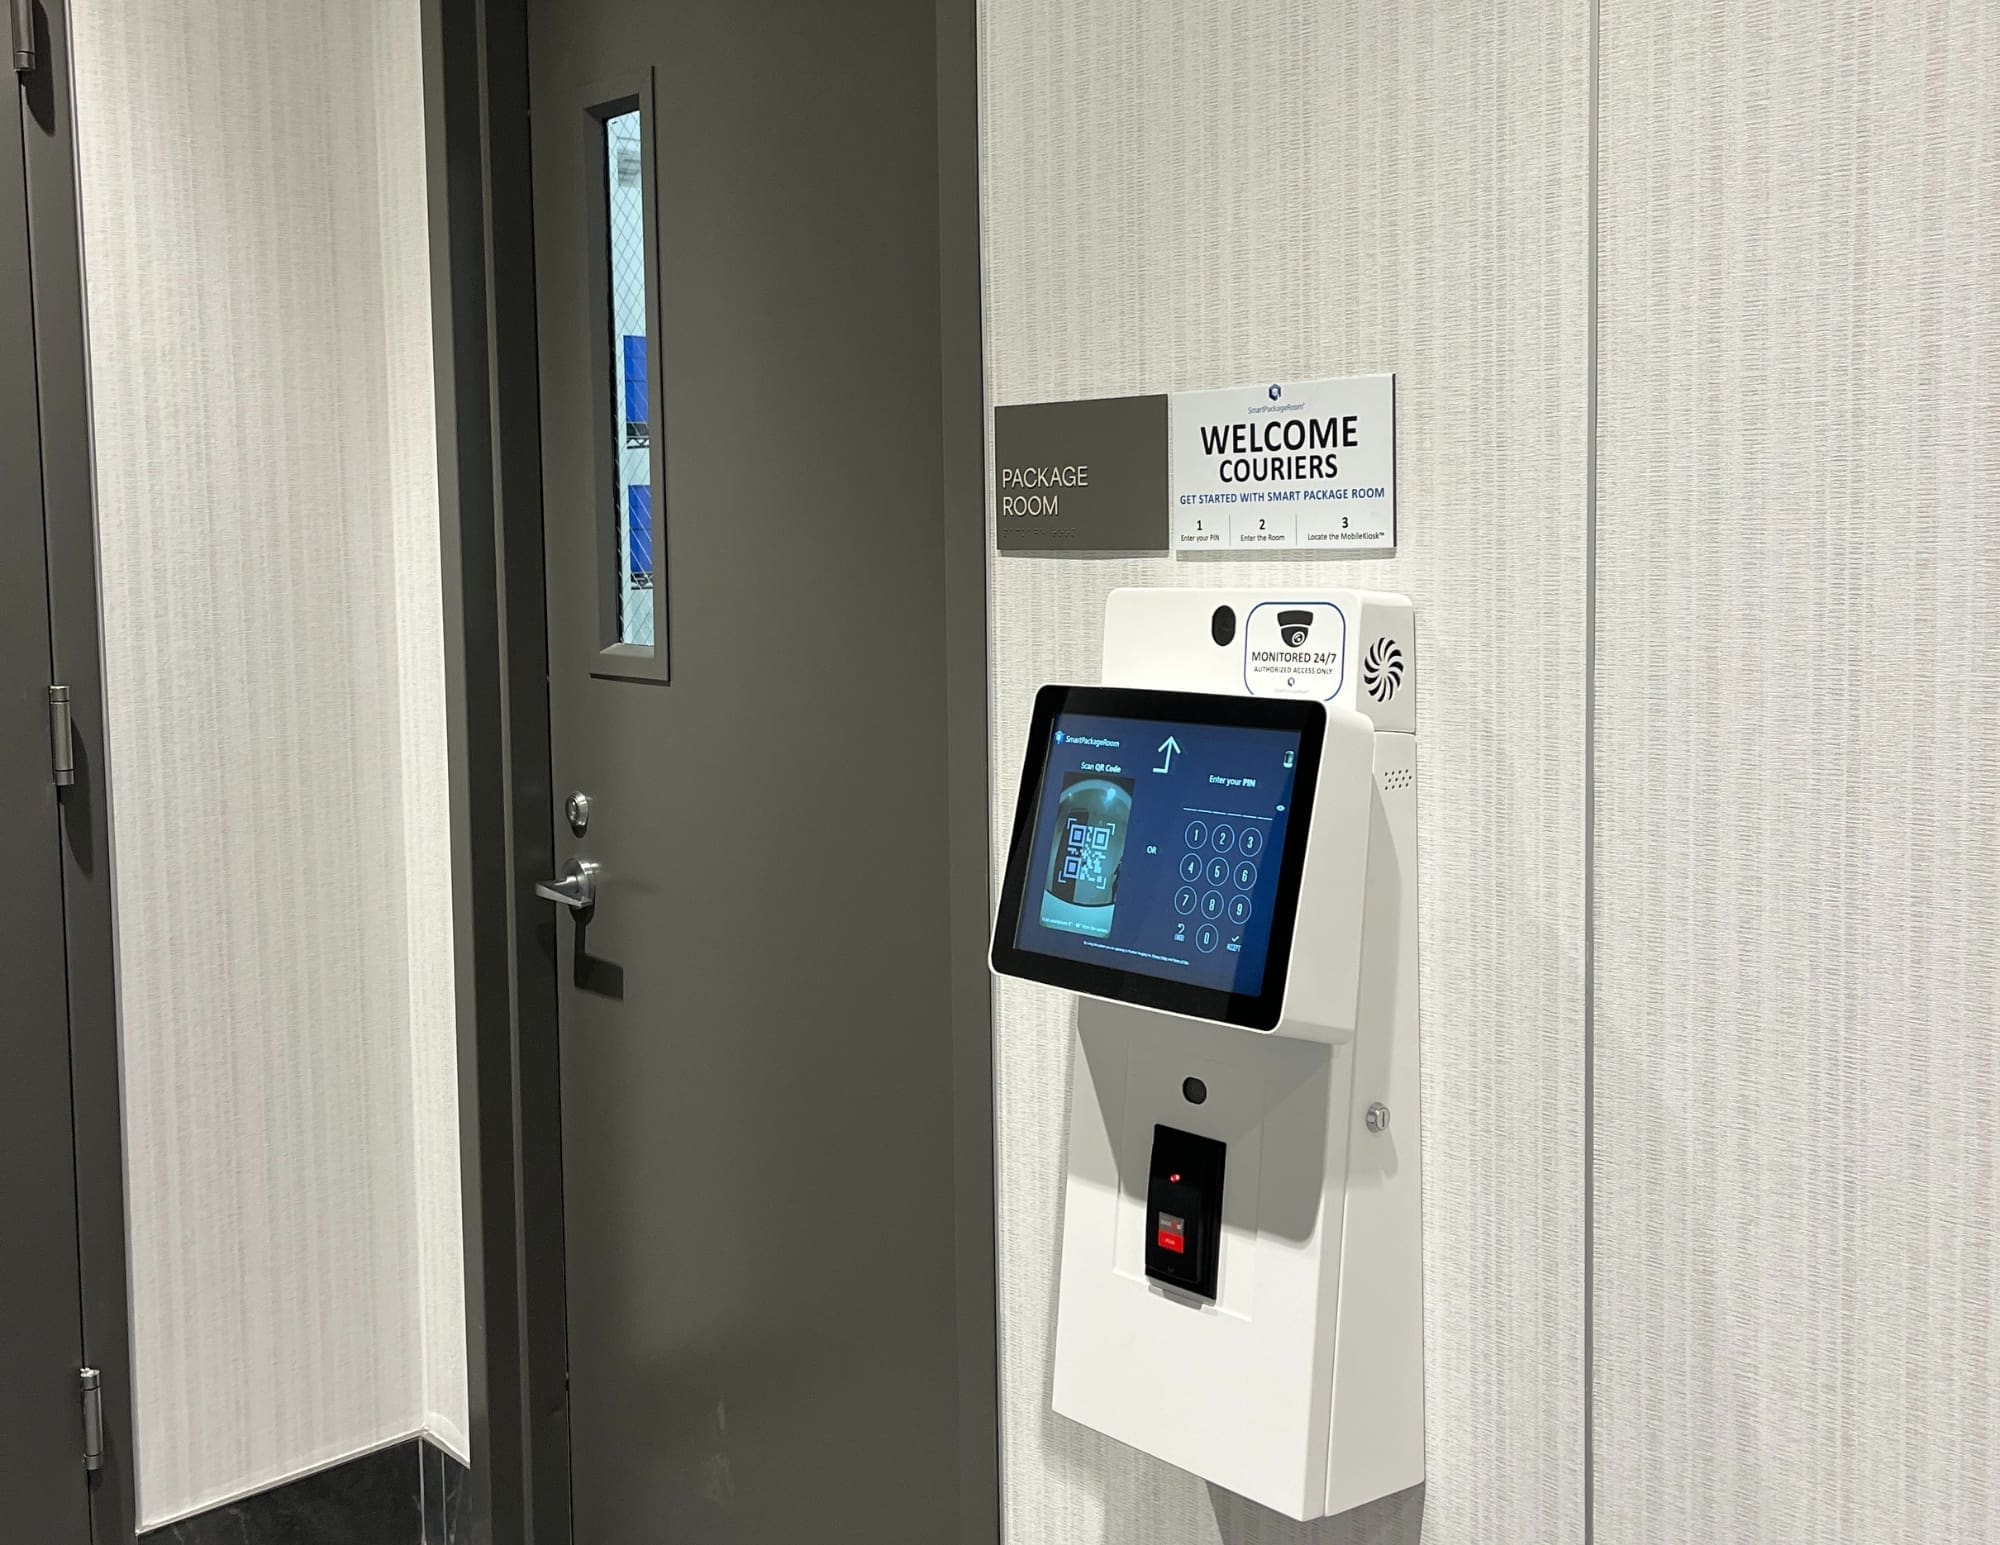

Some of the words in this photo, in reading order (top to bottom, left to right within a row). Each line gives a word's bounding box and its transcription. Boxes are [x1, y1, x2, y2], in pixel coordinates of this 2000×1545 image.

[1200, 415, 1359, 455] WELCOME
[1219, 453, 1338, 483] COURIERS
[1002, 465, 1089, 488] PACKAGE
[1179, 495, 1197, 505] GET
[1198, 493, 1238, 504] STARTED
[1239, 491, 1265, 502] WITH
[1267, 490, 1301, 502] SMART
[1303, 489, 1349, 500] PACKAGE
[1351, 487, 1385, 499] ROOM
[1002, 495, 1059, 516] ROOM
[1196, 519, 1203, 531] 1
[1258, 518, 1266, 530] 2
[1341, 516, 1349, 529] 3
[1180, 534, 1198, 542] Enter
[1199, 535, 1211, 543] your
[1307, 533, 1327, 541] Locate
[1251, 651, 1311, 663] MONITORED
[1313, 651, 1337, 666] 24/7
[1253, 665, 1292, 674] AUTHORIZED
[1292, 667, 1315, 675] ACCESS
[1316, 667, 1333, 675] ONLY
[1065, 735, 1120, 748] SmartPackageRoom
[1080, 761, 1094, 771] Scan
[1094, 763, 1105, 772] QR
[1105, 764, 1122, 773] Code
[1209, 774, 1226, 785] Enter
[1226, 777, 1242, 787] your
[1242, 778, 1256, 788] PIN
[1193, 829, 1199, 842] 1
[1219, 832, 1226, 846] 2
[1246, 836, 1254, 849] 3
[1146, 845, 1158, 855] OR
[1187, 861, 1195, 874] 4
[1214, 865, 1221, 878] 5
[1241, 869, 1249, 882] 6
[1182, 894, 1190, 907] 7
[1208, 898, 1216, 912] 8
[1236, 903, 1243, 916] 9
[1203, 932, 1210, 945] 0
